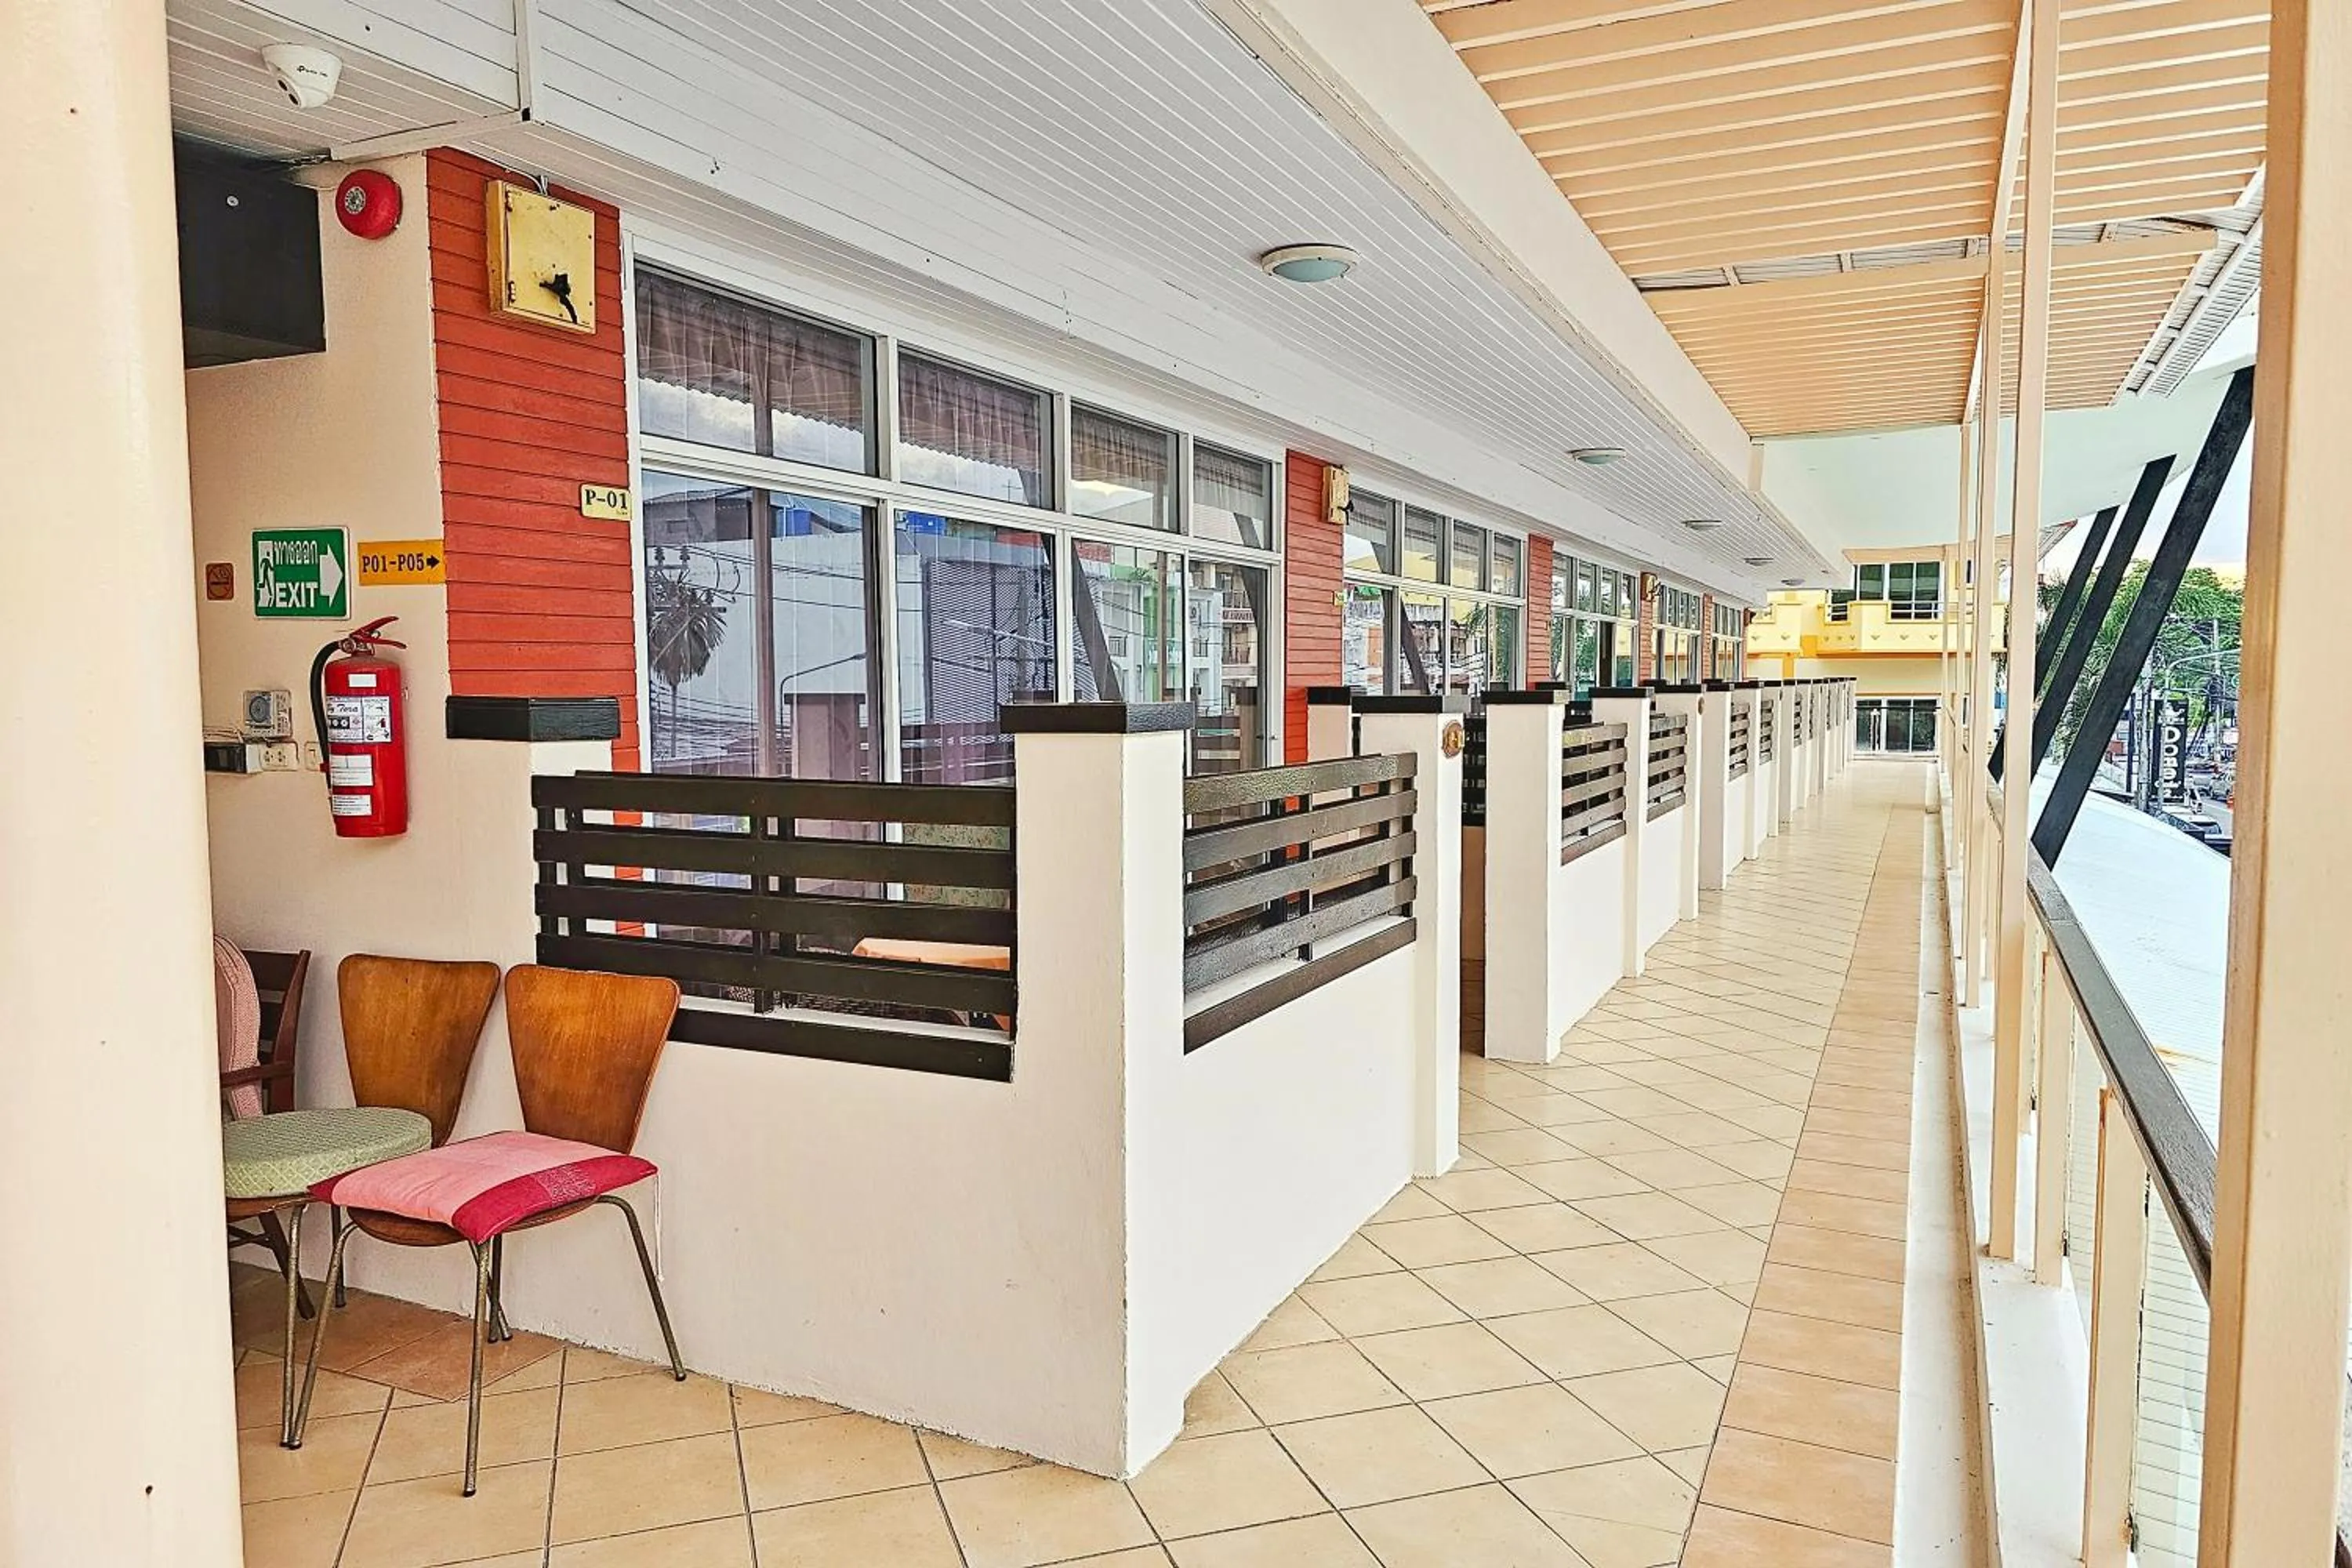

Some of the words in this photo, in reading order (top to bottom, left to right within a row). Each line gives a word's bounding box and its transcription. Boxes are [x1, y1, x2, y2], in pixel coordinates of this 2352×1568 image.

[585, 489, 627, 510] P-01
[274, 539, 318, 564] ทางออก
[362, 554, 424, 573] P01-P05
[276, 582, 318, 608] EXIT
